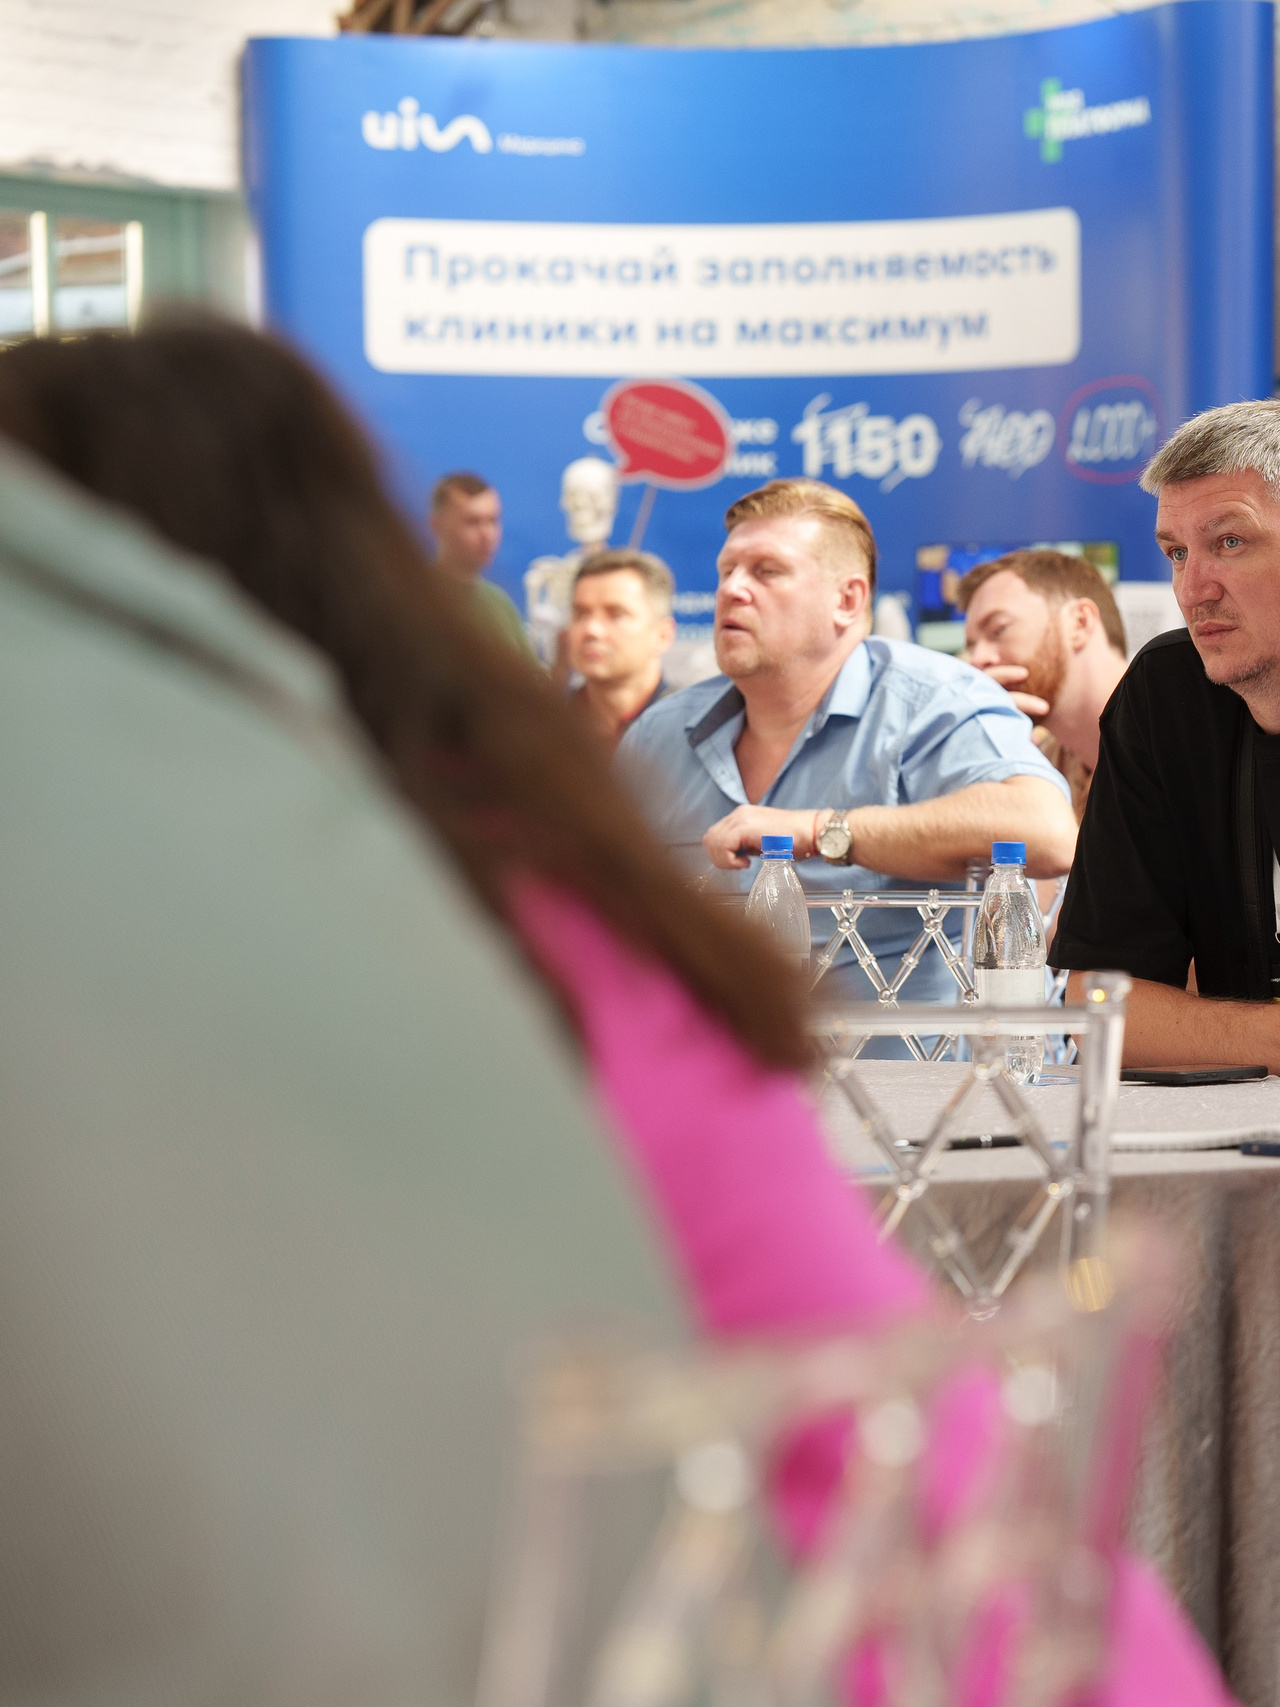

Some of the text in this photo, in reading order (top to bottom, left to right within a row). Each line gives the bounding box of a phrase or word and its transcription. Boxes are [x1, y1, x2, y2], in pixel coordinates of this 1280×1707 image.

[403, 242, 1058, 289] Прокачай заполняемость
[404, 311, 989, 353] клиники на максимум
